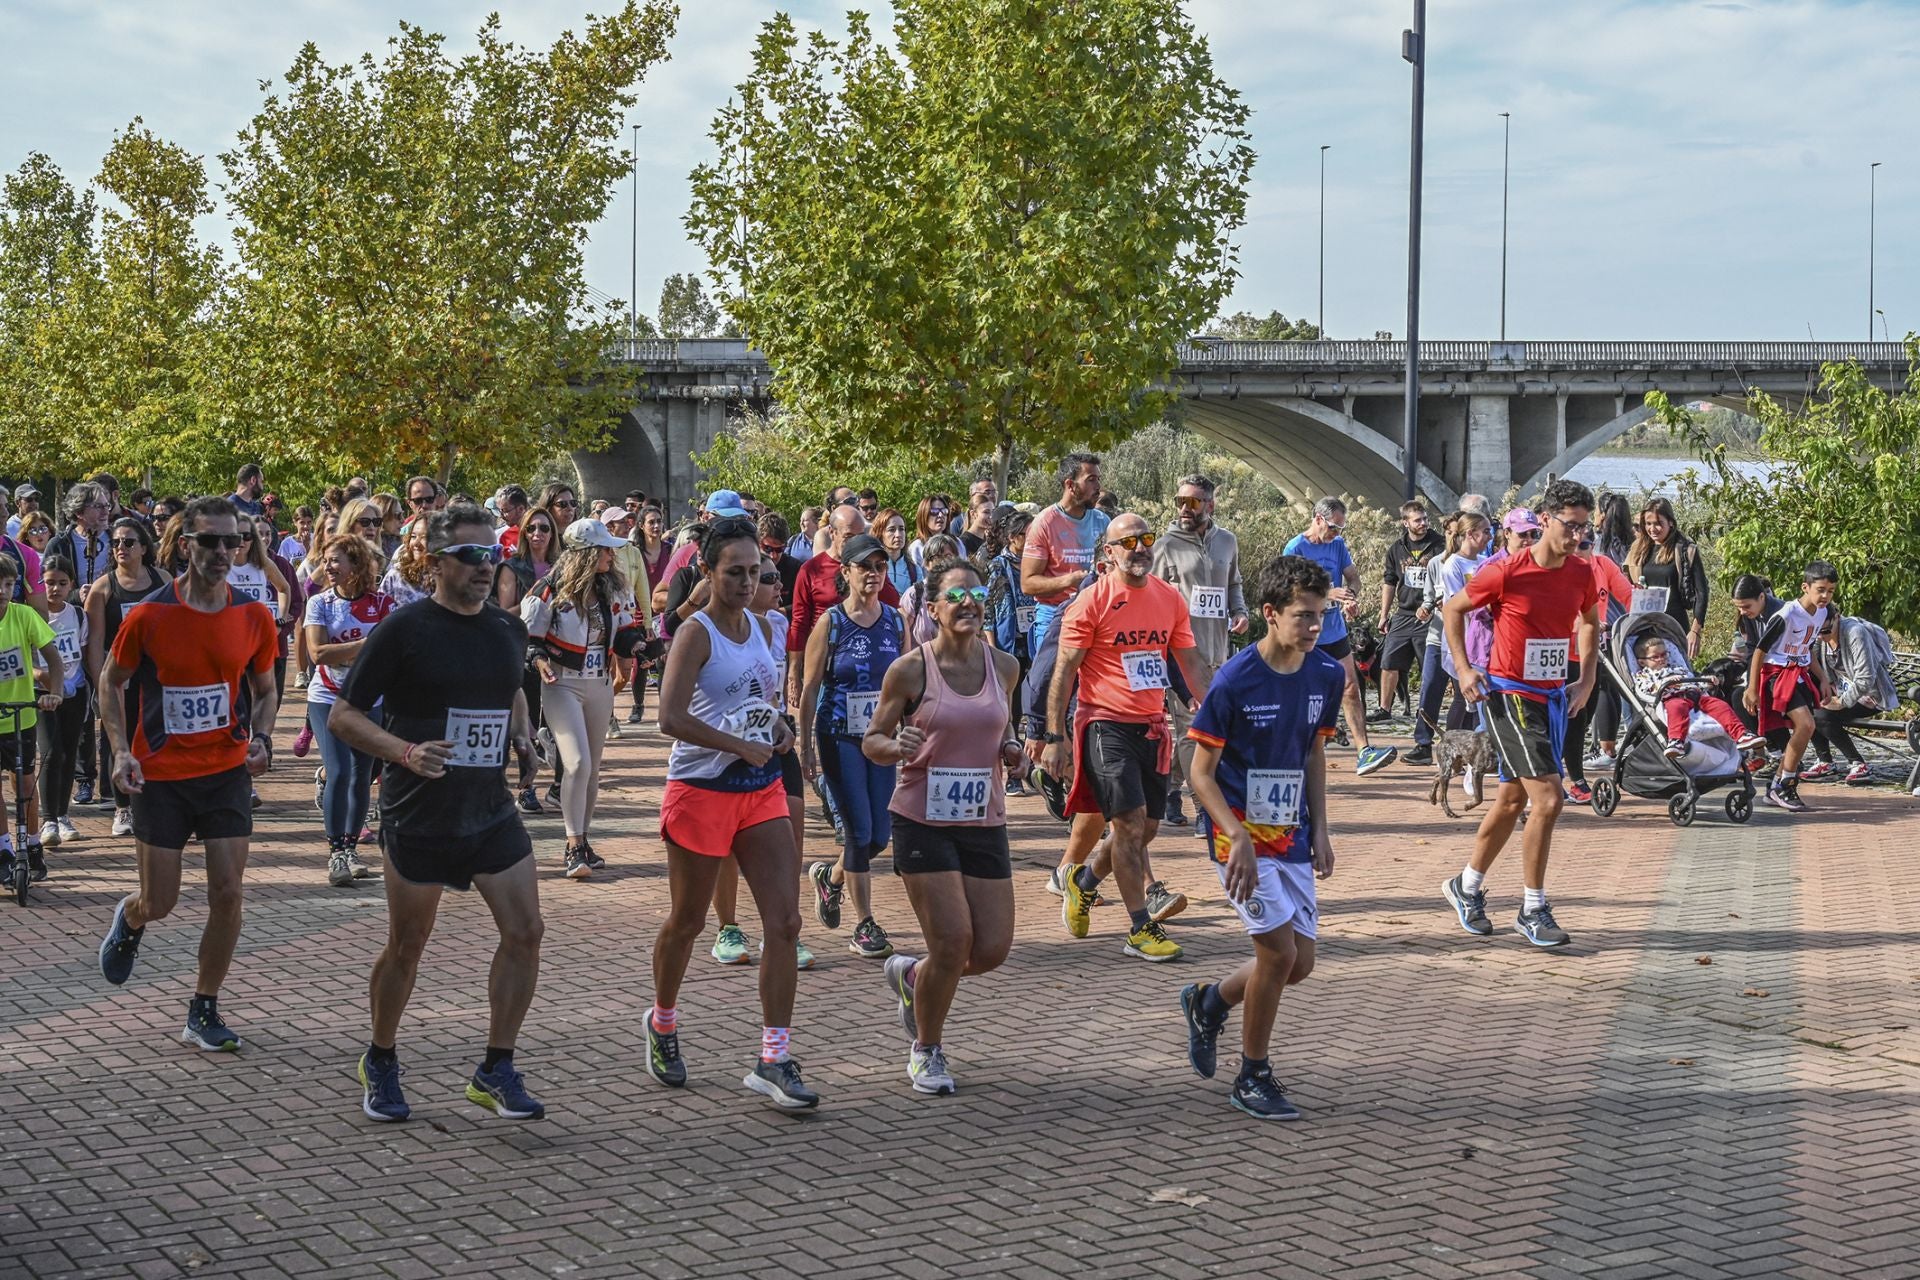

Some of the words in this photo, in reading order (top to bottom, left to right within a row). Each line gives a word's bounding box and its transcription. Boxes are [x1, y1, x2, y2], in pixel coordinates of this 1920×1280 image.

[1199, 593, 1221, 608] 970
[1112, 630, 1168, 646] ASFAS
[1540, 649, 1565, 667] 558
[1136, 660, 1163, 678] 455
[724, 665, 755, 697] READY
[181, 695, 222, 719] 387
[863, 701, 878, 720] 4
[1250, 704, 1281, 712] Santander
[466, 723, 503, 748] 557
[947, 780, 986, 804] 448
[1268, 783, 1299, 808] 447
